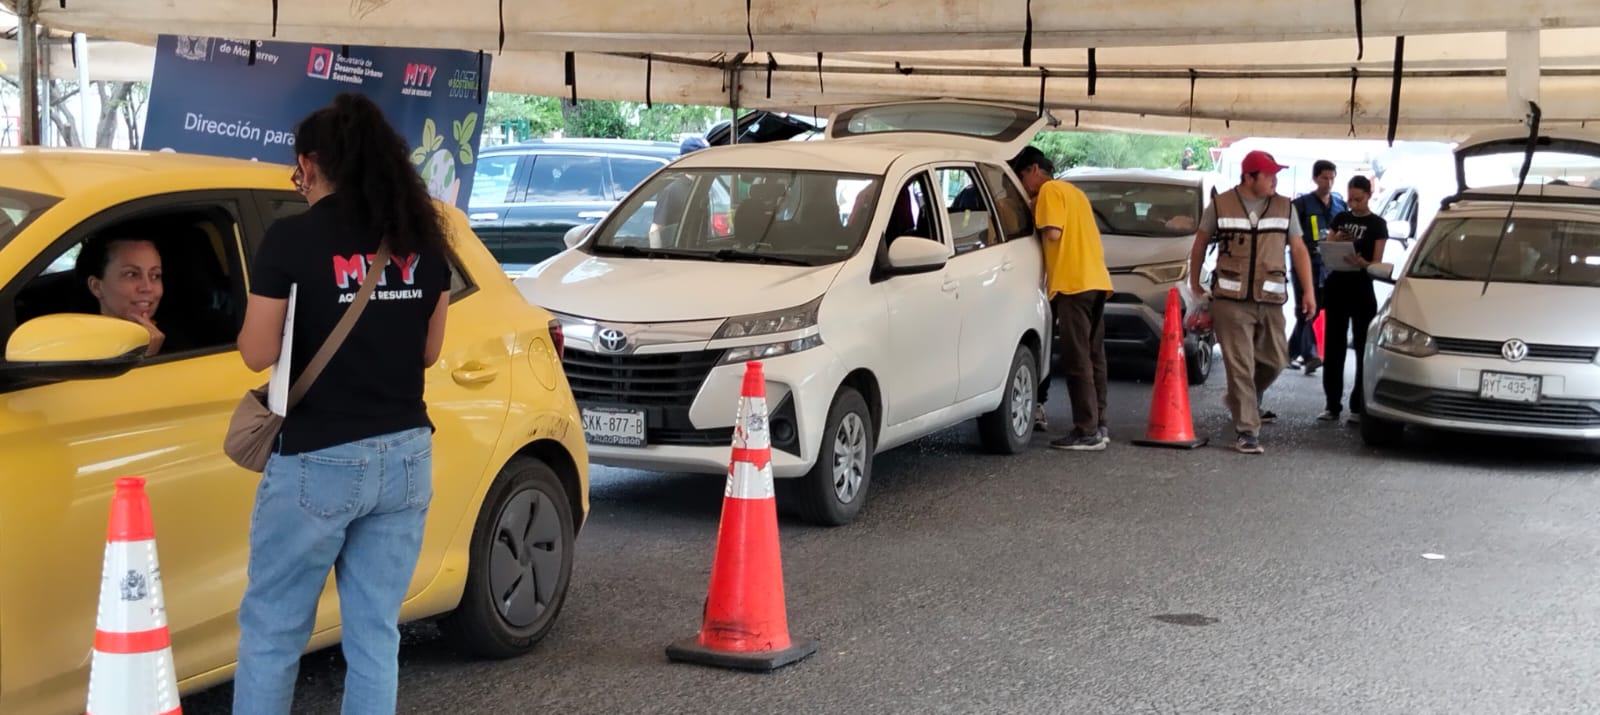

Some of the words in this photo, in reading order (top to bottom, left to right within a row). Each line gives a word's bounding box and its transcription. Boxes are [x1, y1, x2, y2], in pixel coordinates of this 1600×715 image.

[232, 45, 279, 64] Moerrey
[403, 63, 436, 88] MTY
[184, 112, 261, 141] Dirección
[263, 129, 296, 146] para
[333, 253, 420, 289] MTY
[582, 414, 643, 434] SKK-877-B
